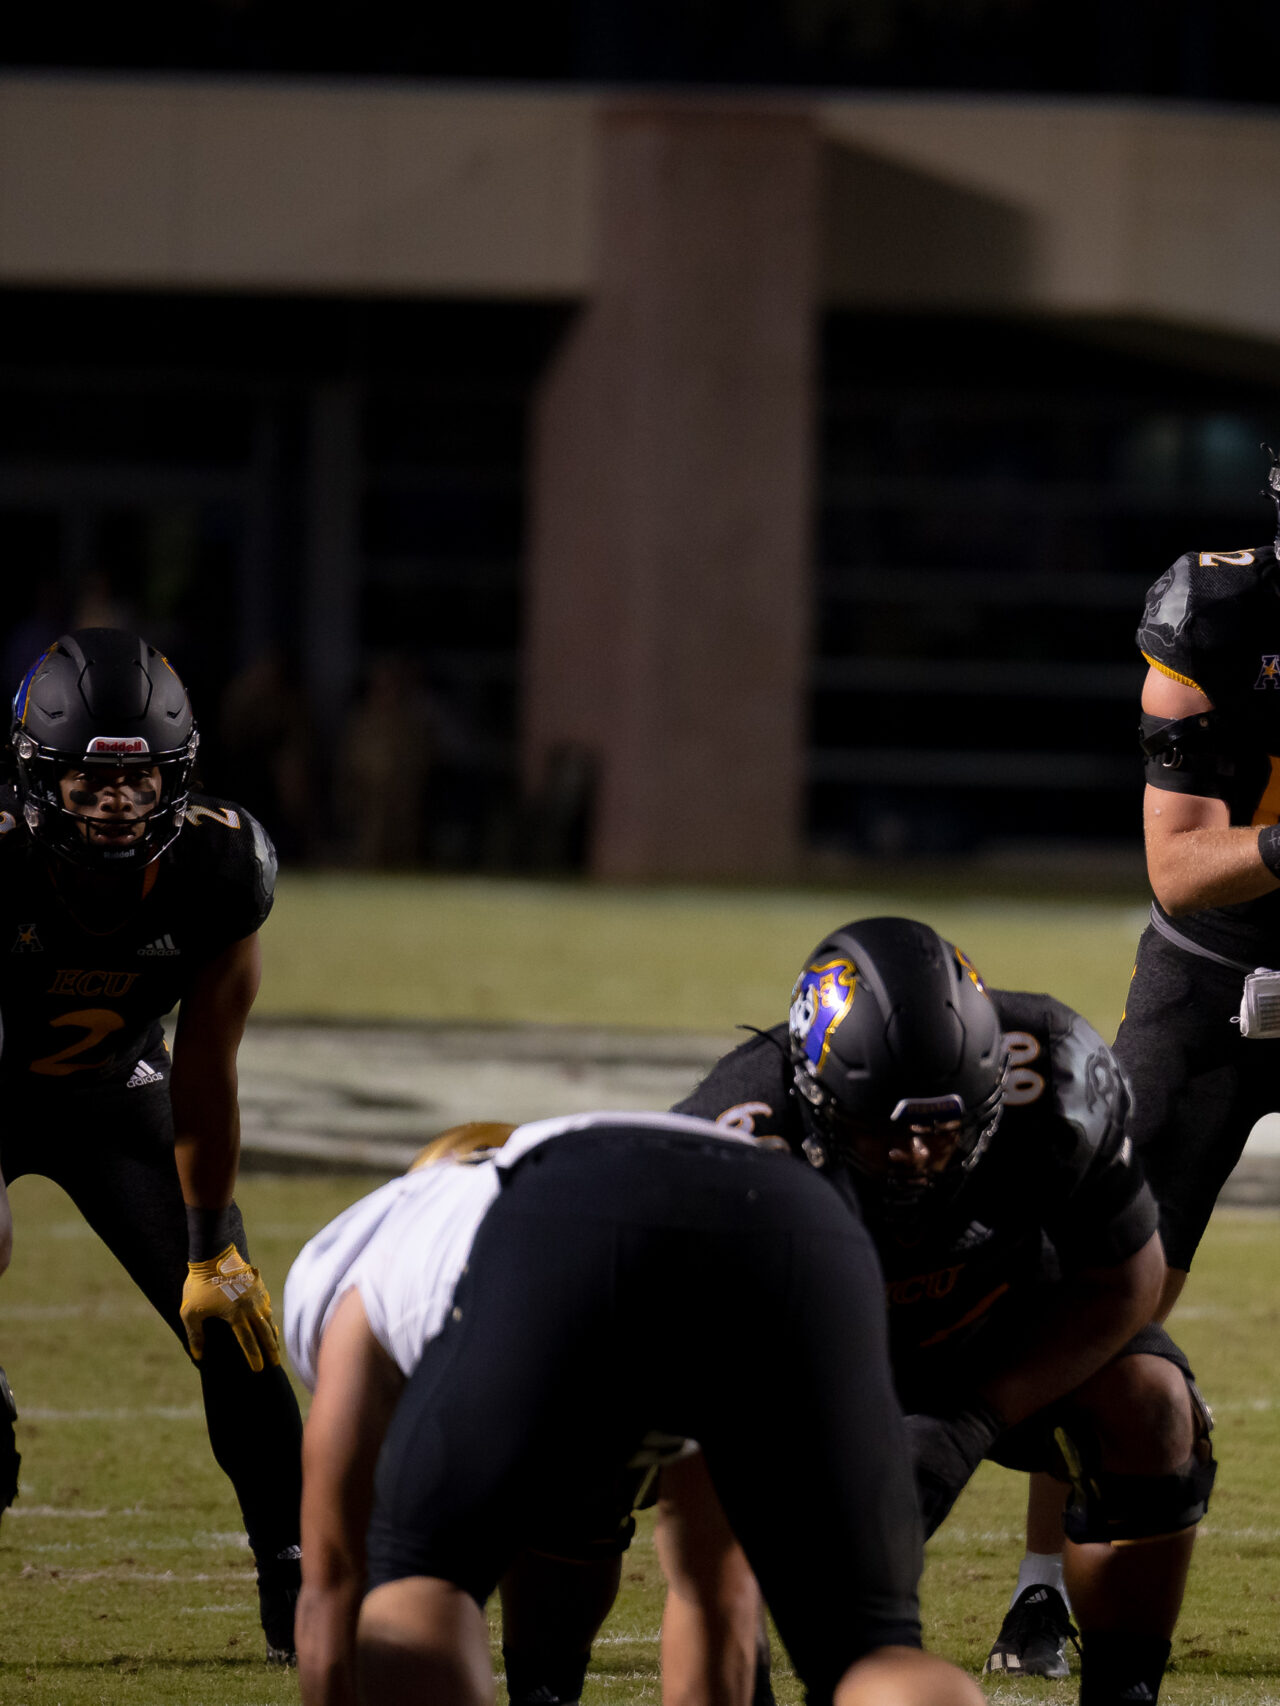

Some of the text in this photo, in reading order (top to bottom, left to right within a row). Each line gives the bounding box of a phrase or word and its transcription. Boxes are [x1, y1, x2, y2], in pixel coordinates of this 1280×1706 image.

[1199, 548, 1256, 567] 2
[96, 741, 142, 751] Riddell
[136, 948, 182, 957] adidas
[48, 968, 144, 998] ECU
[28, 1008, 127, 1077] 2
[126, 1071, 164, 1089] adidas
[715, 1101, 792, 1152] 6
[886, 1262, 967, 1305] CU
